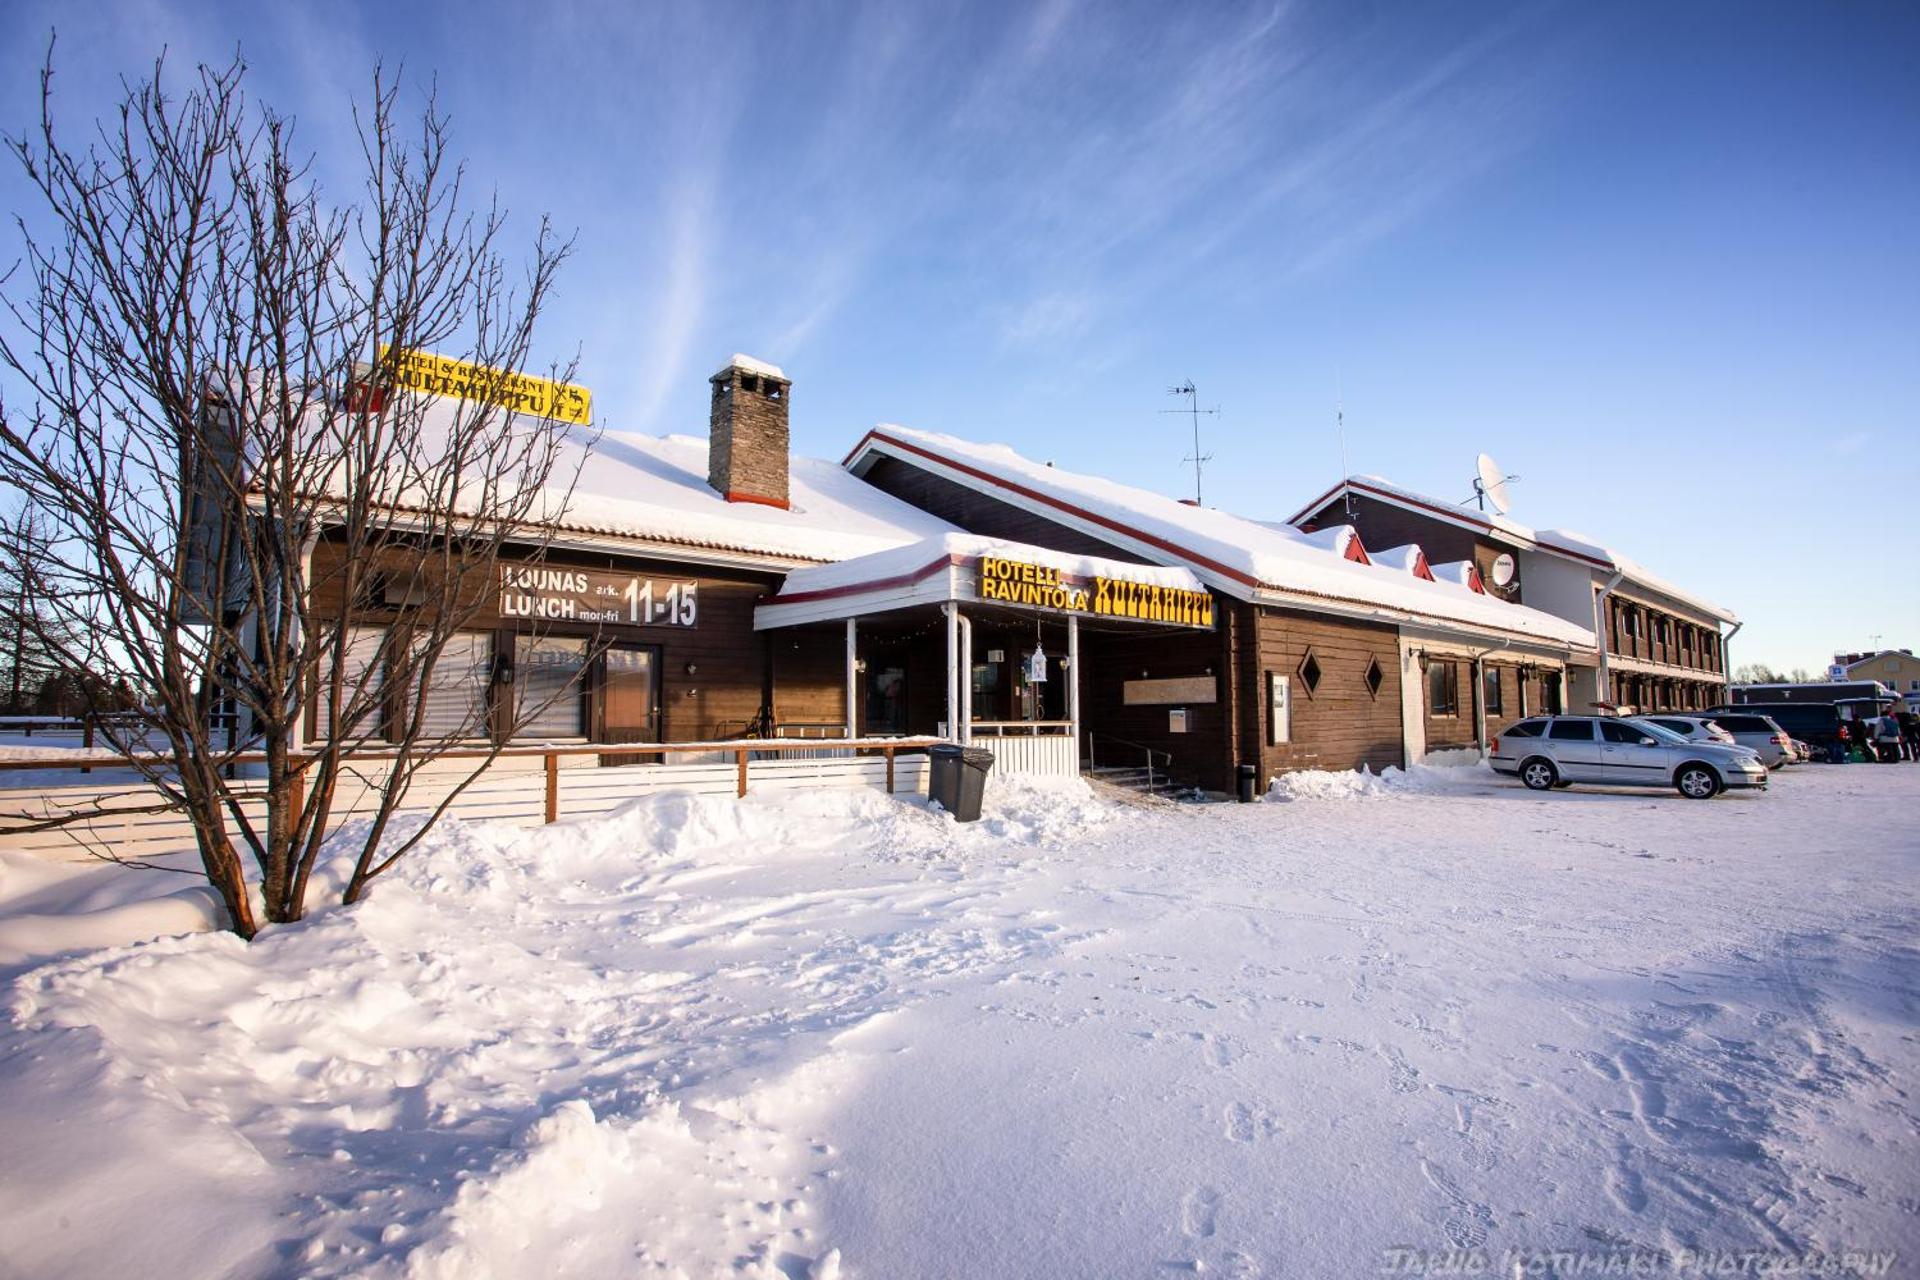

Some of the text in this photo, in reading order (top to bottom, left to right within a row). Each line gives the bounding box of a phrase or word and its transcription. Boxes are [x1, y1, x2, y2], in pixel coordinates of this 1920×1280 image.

[383, 350, 436, 370] TEL
[441, 362, 454, 373] &
[387, 367, 546, 413] ULTAHPPU
[506, 566, 619, 596] LOUNAS ark.
[983, 557, 1060, 586] HOTELLI
[505, 594, 619, 622] LUNCH mon-fri
[624, 579, 696, 625] 11-15
[982, 578, 1088, 611] RAVINTOLA
[1095, 576, 1212, 625] KULTAHIPPU
